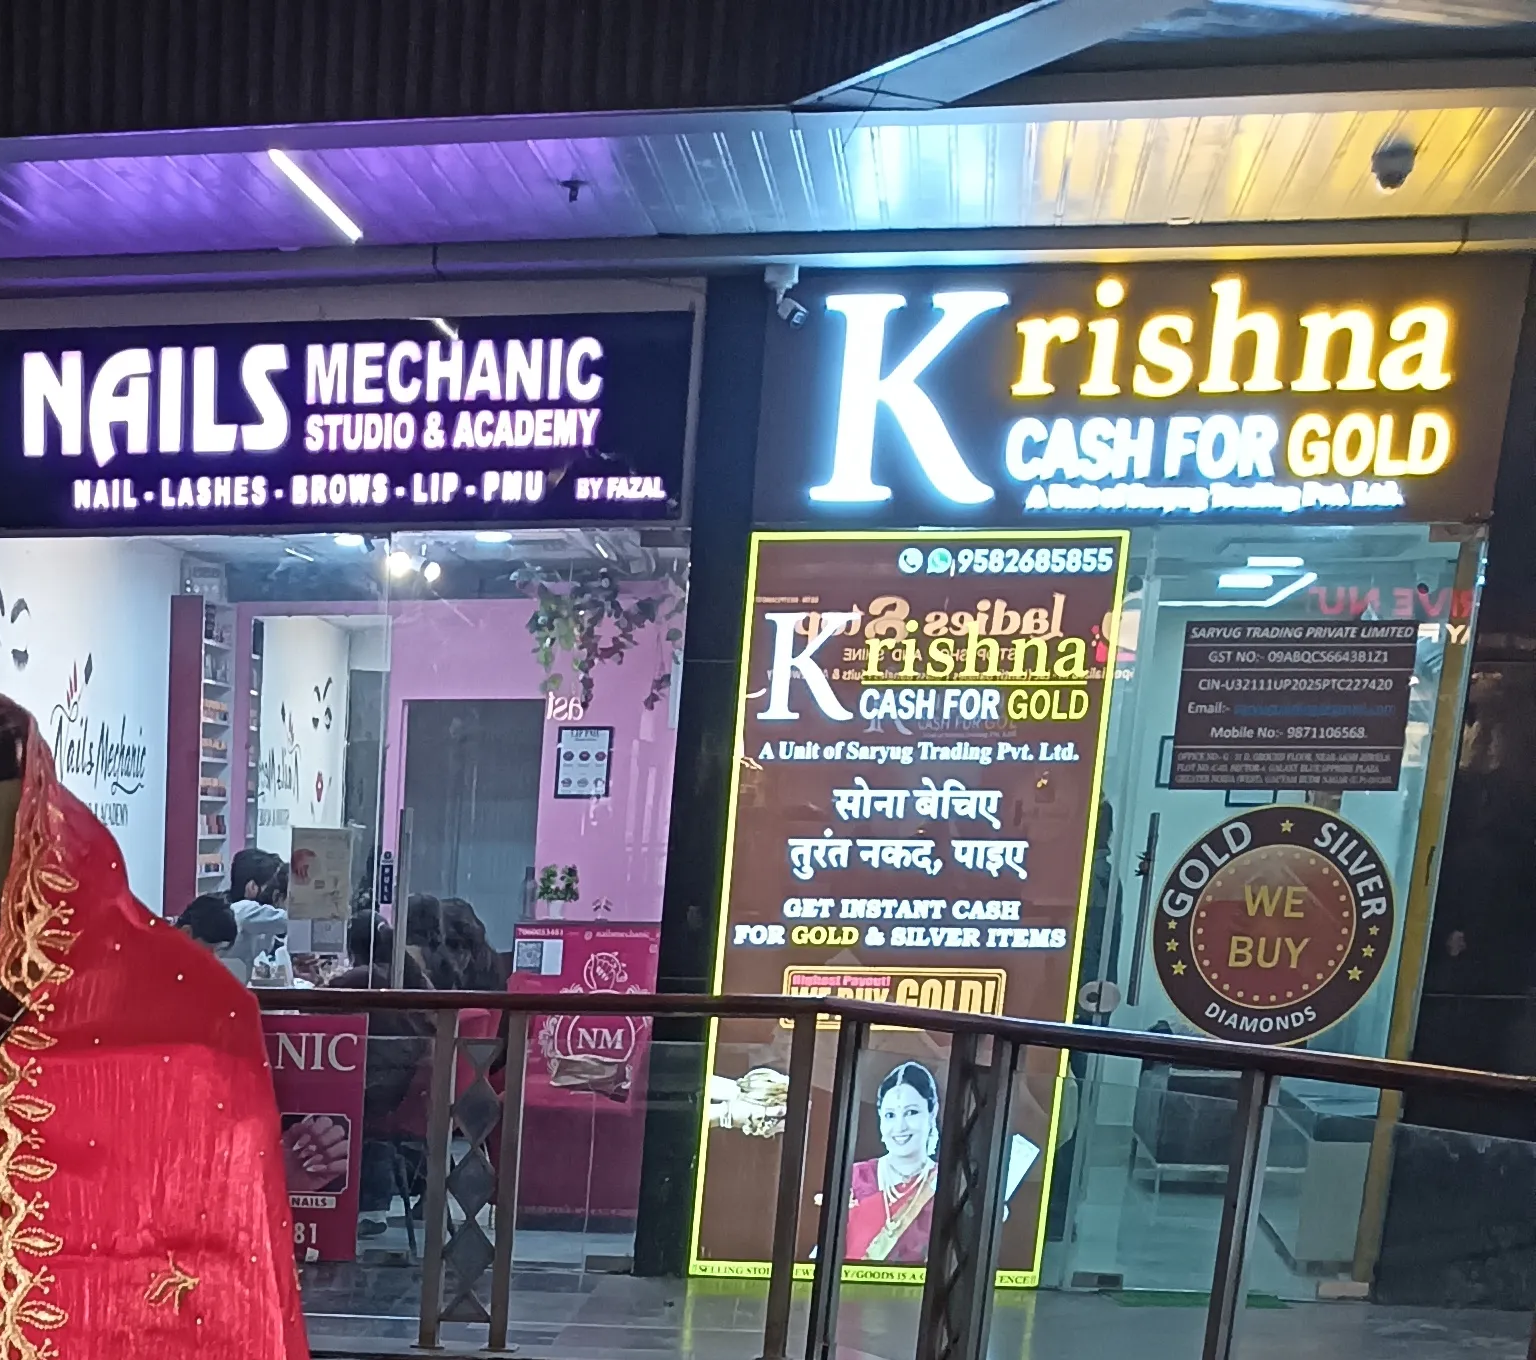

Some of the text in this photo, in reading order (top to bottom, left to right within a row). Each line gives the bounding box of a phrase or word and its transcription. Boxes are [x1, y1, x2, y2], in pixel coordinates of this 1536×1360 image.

[304, 336, 604, 404] MECHANIC
[21, 343, 291, 469] NAILS
[304, 408, 600, 451] STUDIO & ACADEMY
[1006, 412, 1451, 482] CASH FOR GOLD
[73, 470, 665, 511] NAIL LASHES BROWS LIP PMU BY FAZAL
[958, 547, 1113, 575] 9582685855
[1191, 626, 1242, 639] SARYUG
[1246, 626, 1303, 639] TRADING
[1305, 626, 1357, 639] PRIVATE
[1360, 626, 1414, 639] LIMITED
[1208, 650, 1233, 664] GST
[860, 688, 1089, 721] CASH FOR GOLD
[1187, 701, 1231, 715] Email:-
[50, 703, 95, 783] Nails
[1210, 725, 1254, 739] Mobile
[758, 741, 1079, 766] A Unit of Saryug Trading Pvt. Ltd.
[833, 776, 1004, 829] सोना बेचिए
[788, 828, 1030, 880] तुरंत नकद, पाइए
[1162, 820, 1387, 919] GOLD SILVER
[783, 898, 1022, 921] GET INSTANT CASH
[1244, 884, 1309, 918] WE
[733, 925, 1068, 949] FOR GOLD & SILVER ITEMS
[1228, 935, 1312, 969] BUY
[1205, 1002, 1317, 1033] DIAMONDS
[576, 1027, 624, 1050] NM
[291, 1196, 327, 1208] NAILS
